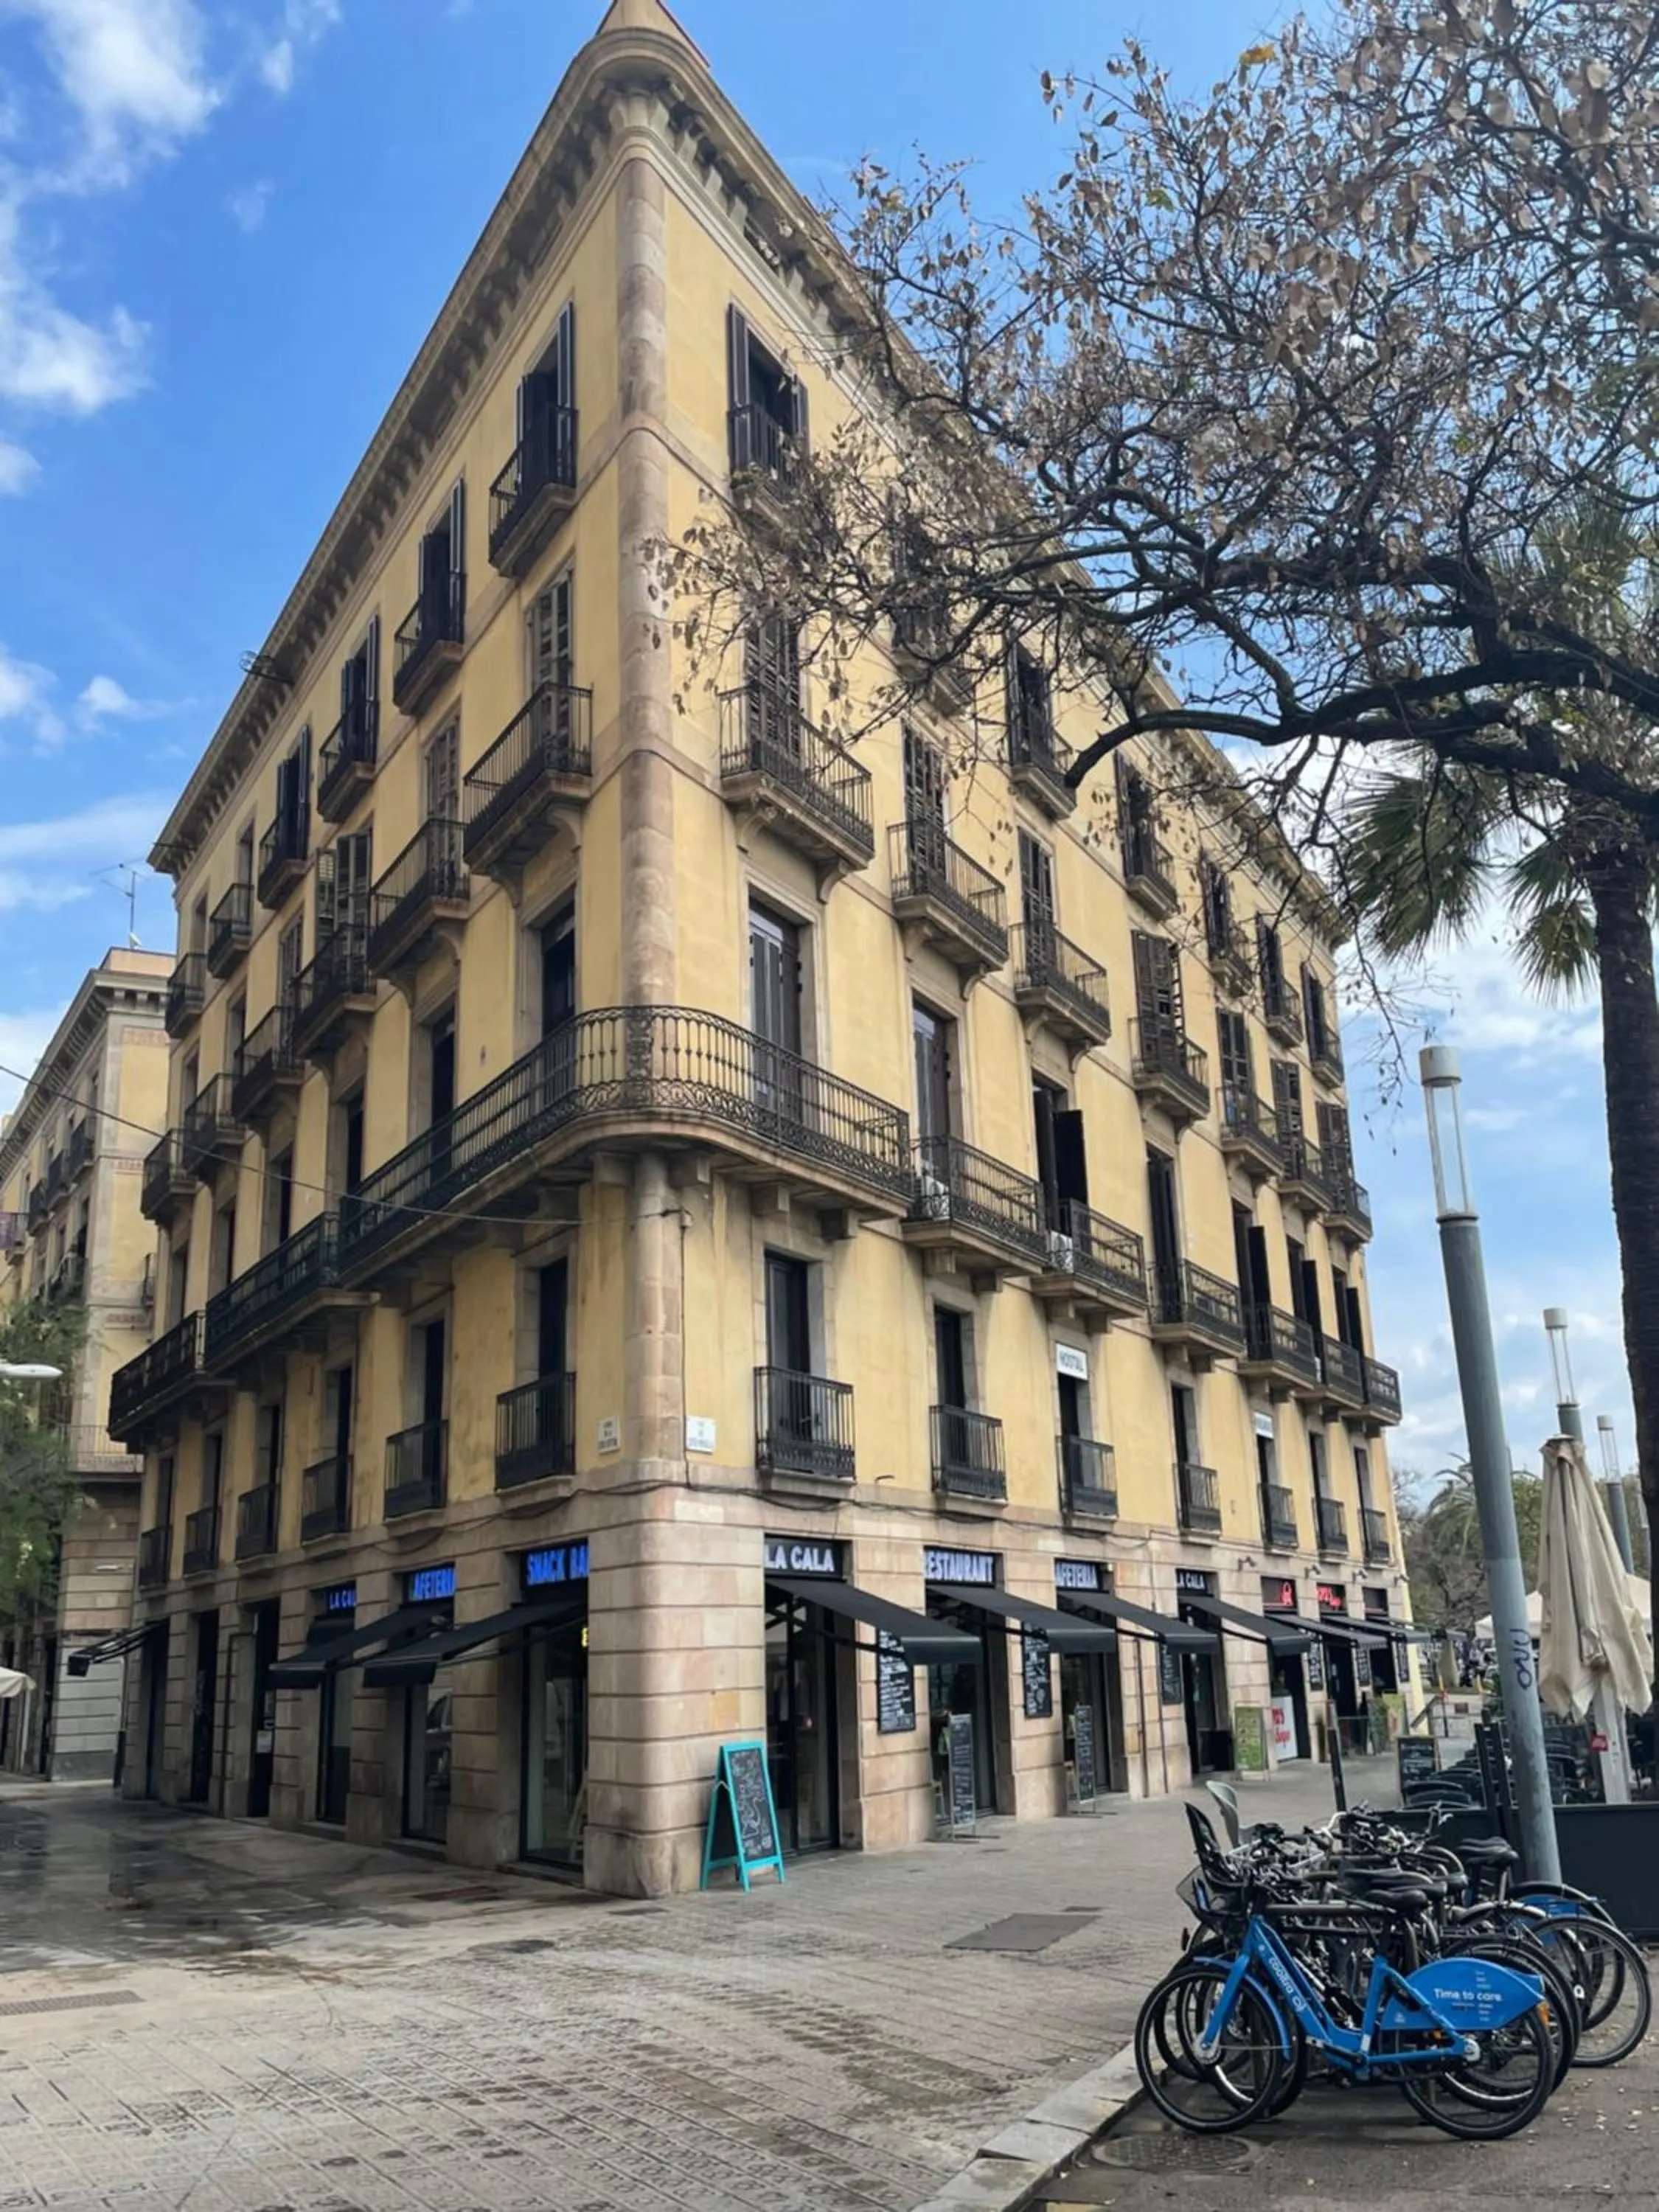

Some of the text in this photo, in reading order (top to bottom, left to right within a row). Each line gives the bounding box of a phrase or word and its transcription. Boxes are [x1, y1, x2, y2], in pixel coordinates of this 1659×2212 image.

[527, 1544, 588, 1586] SNACK BA
[765, 1545, 835, 1573] LA CALA
[1057, 1563, 1098, 1589] AFETERIA
[1433, 1988, 1460, 2000] Time
[1461, 1990, 1475, 2001] to
